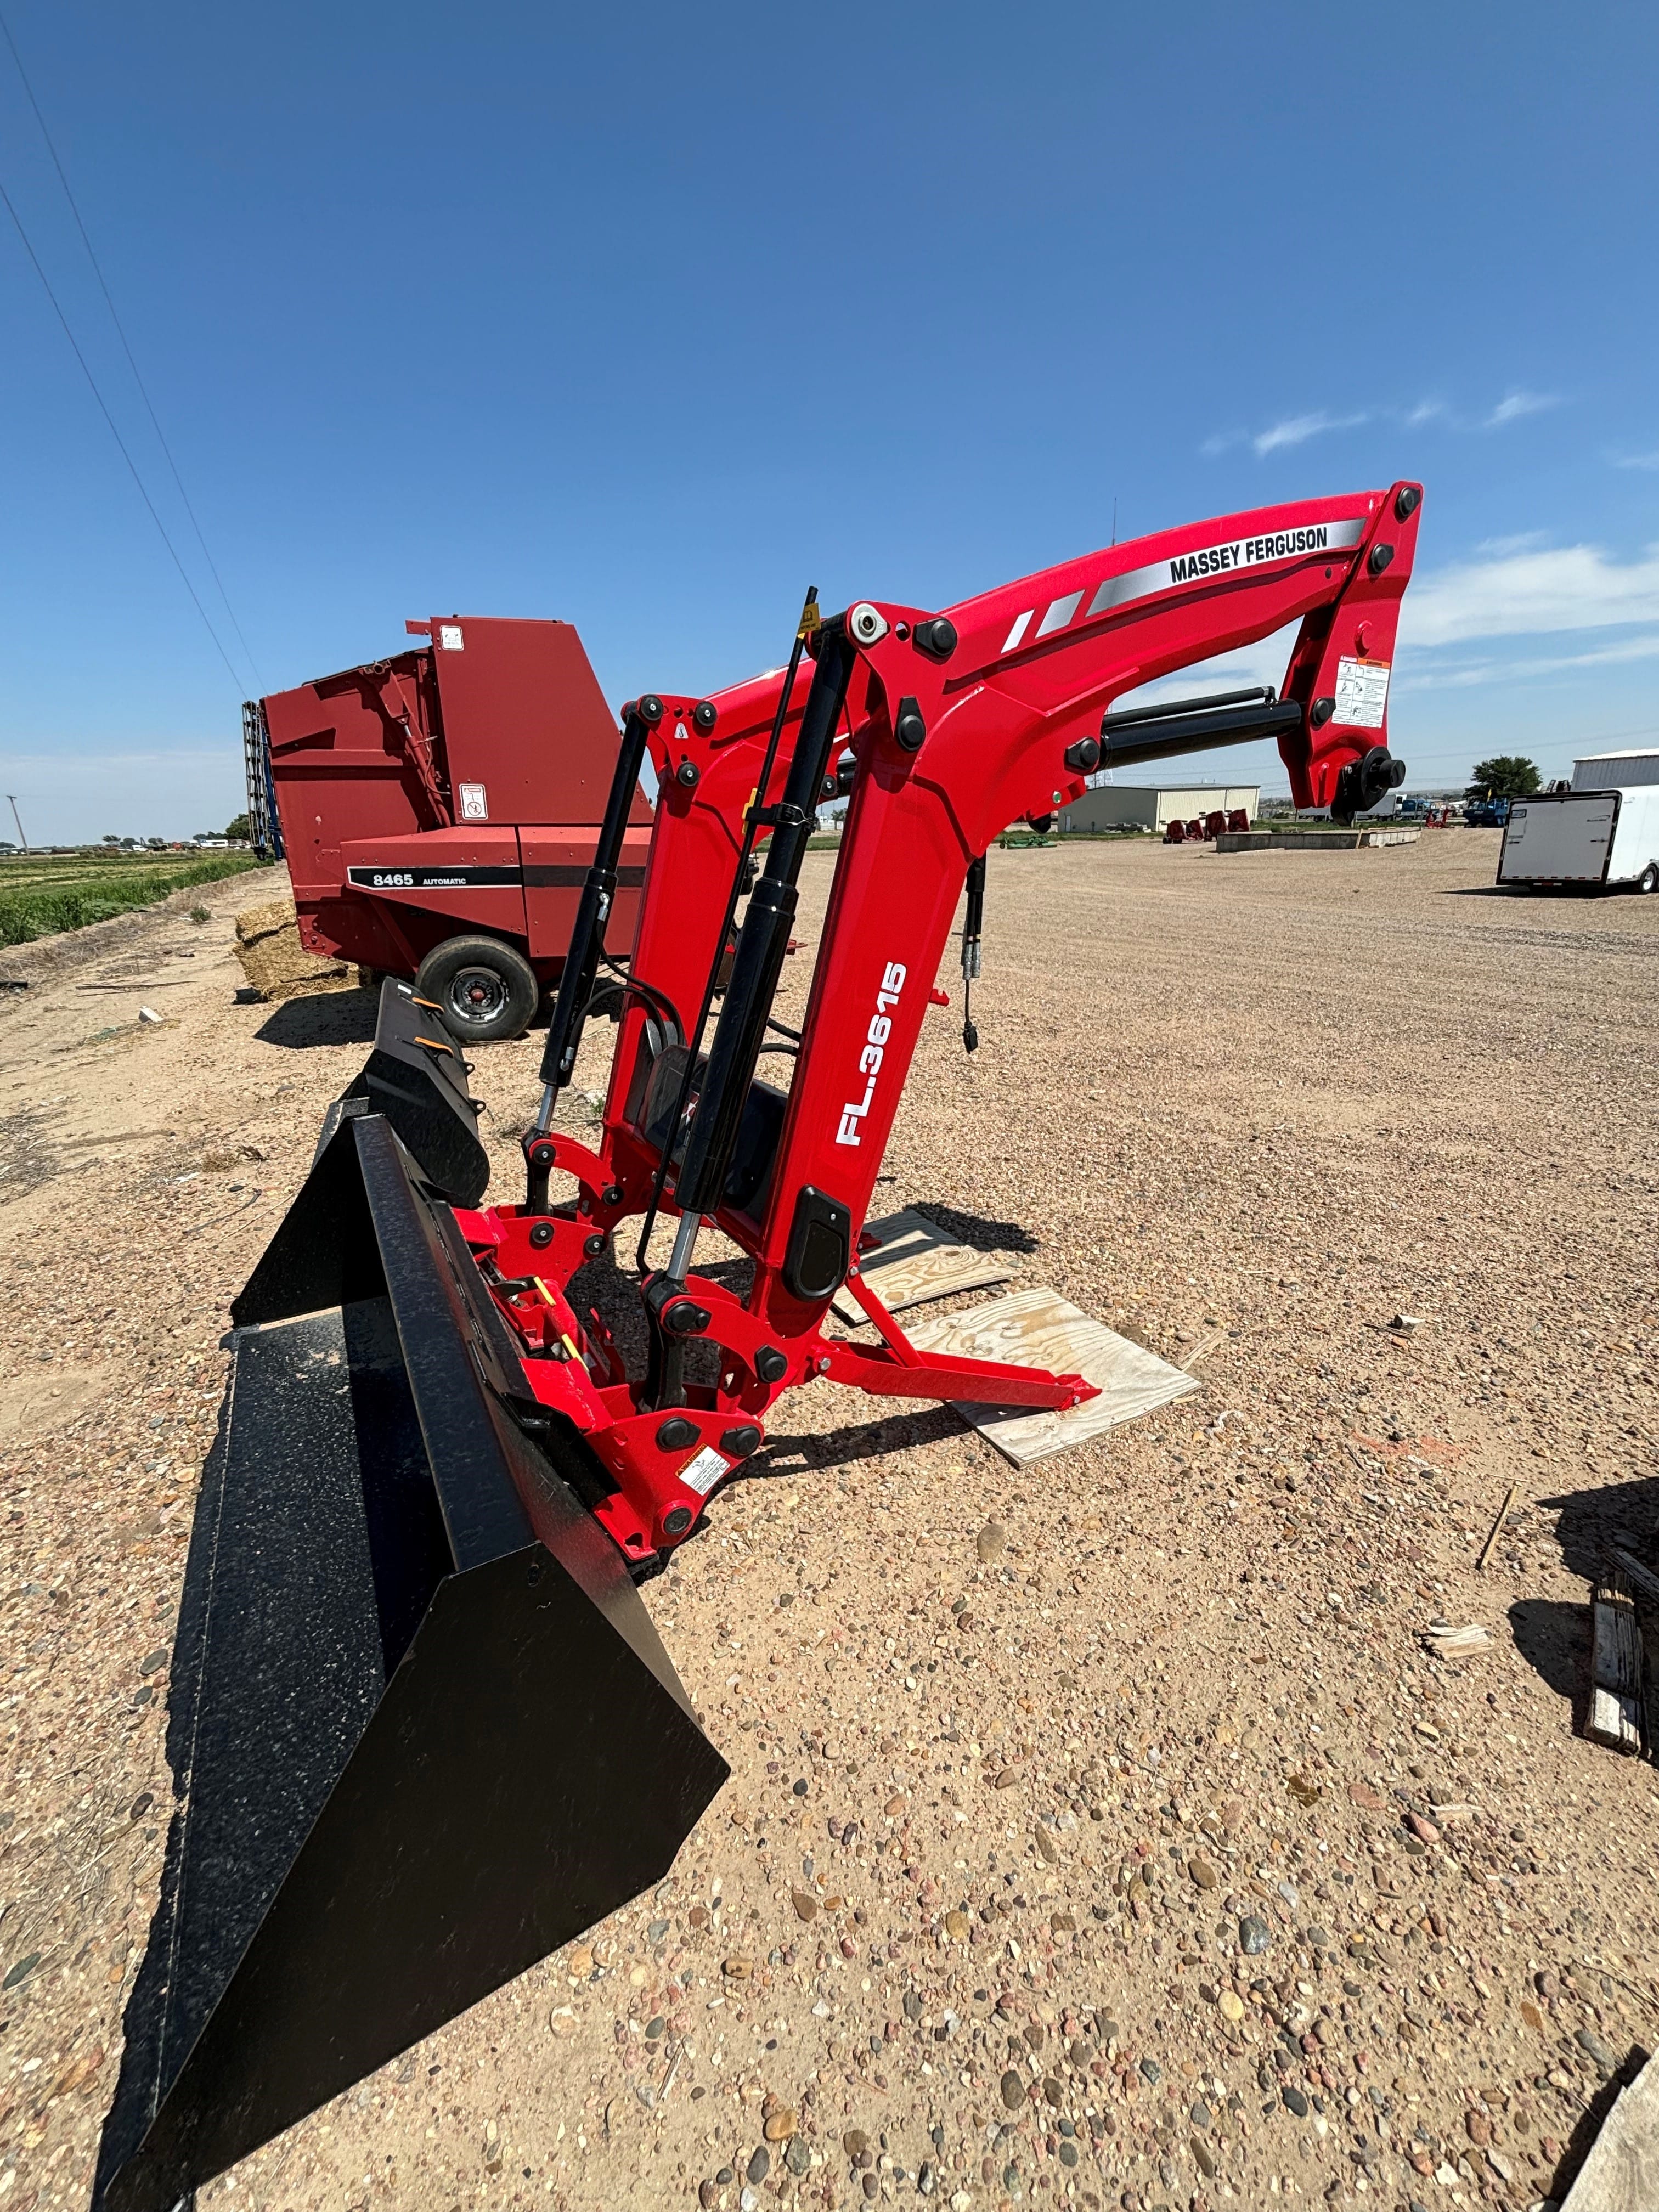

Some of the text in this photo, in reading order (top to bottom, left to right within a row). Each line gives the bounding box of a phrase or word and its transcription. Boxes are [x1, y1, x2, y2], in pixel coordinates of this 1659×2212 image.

[1170, 526, 1327, 583] MASSEY FERGUSON
[374, 874, 413, 886] 8465
[835, 961, 907, 1146] FL.3615
